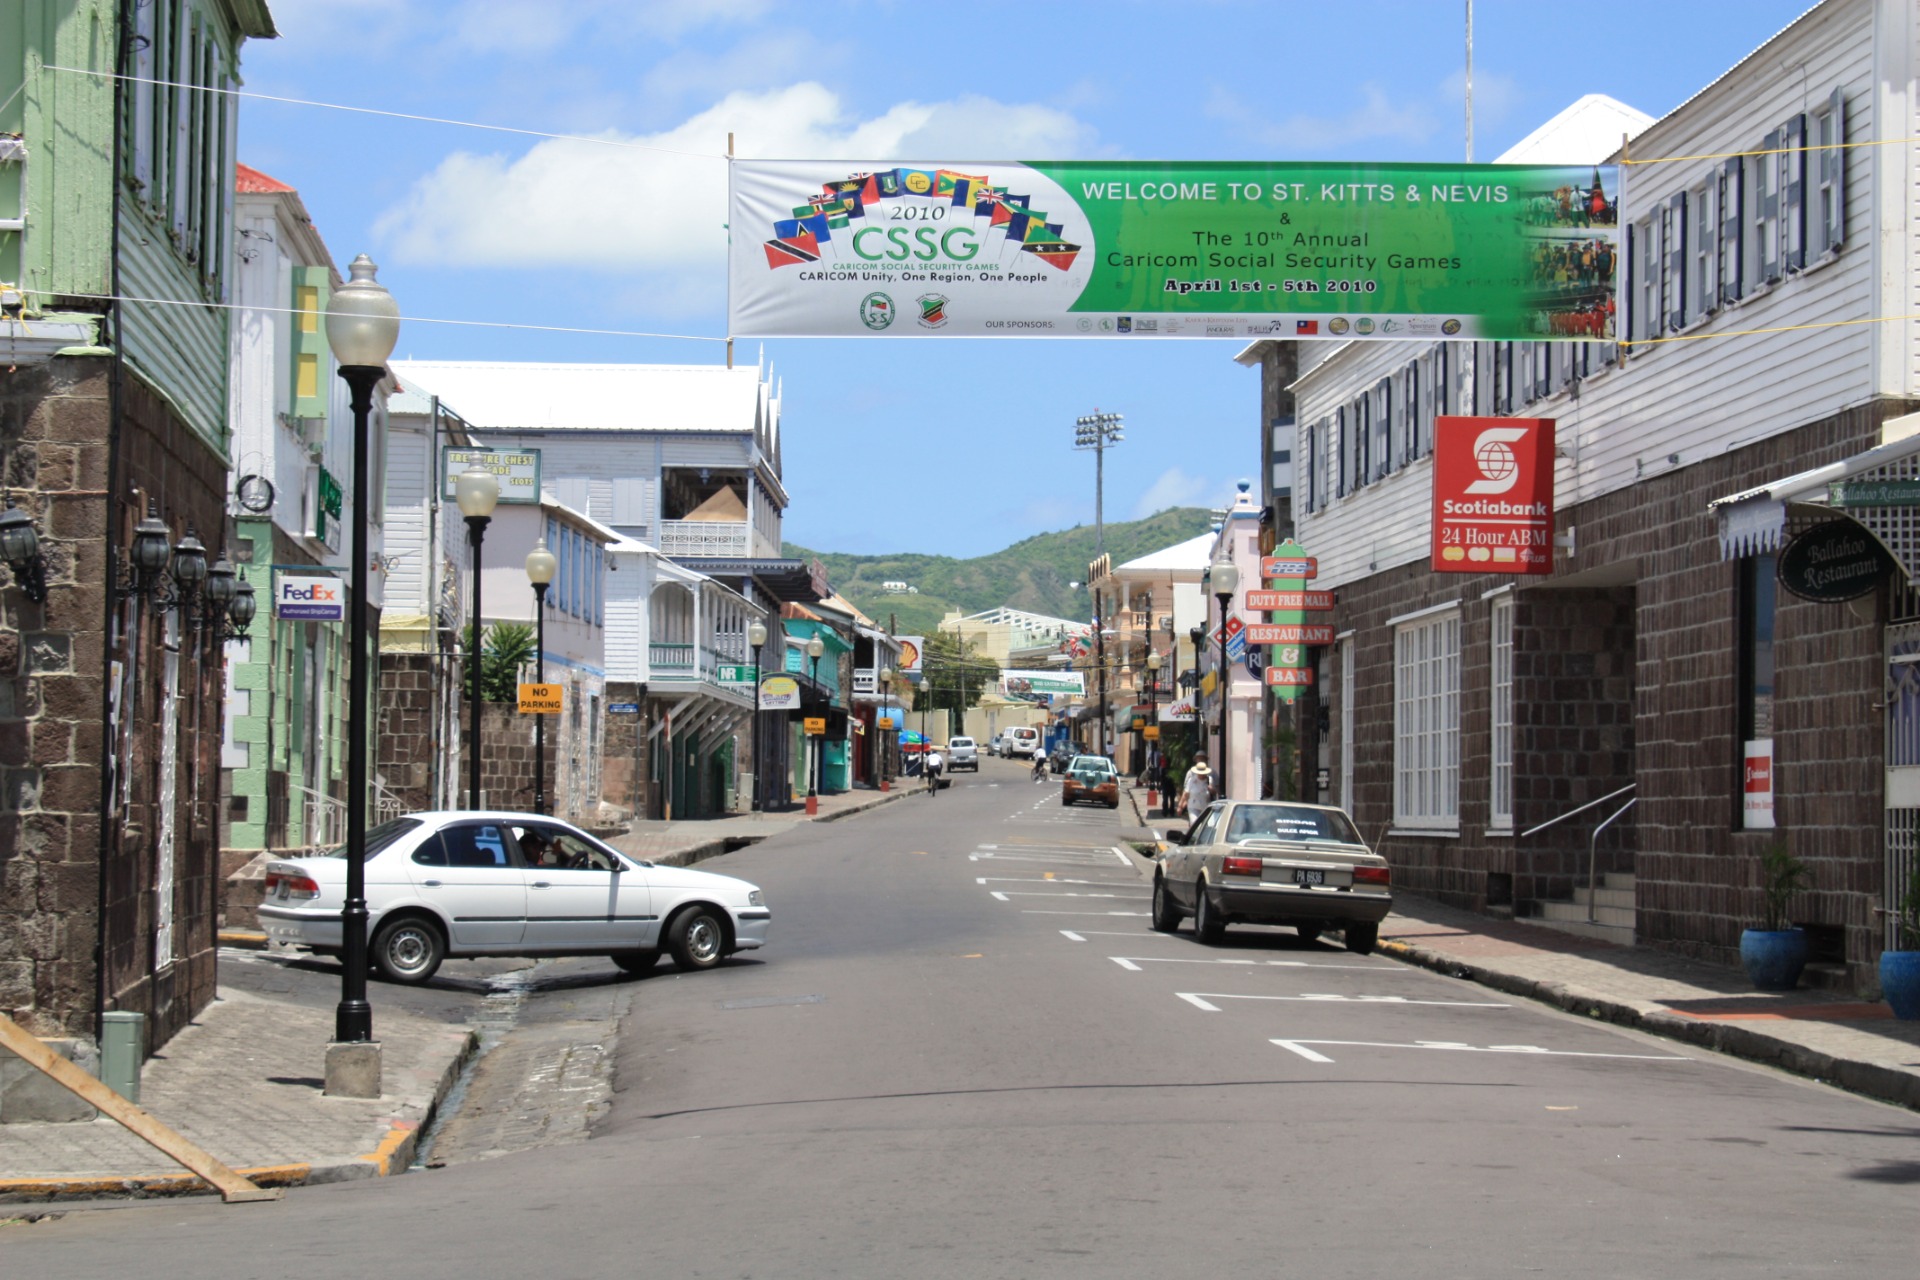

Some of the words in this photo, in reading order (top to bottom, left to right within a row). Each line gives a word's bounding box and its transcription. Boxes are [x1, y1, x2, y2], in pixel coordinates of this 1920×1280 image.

[1082, 182, 1217, 201] WELCOME
[1227, 183, 1262, 201] TO
[1272, 183, 1310, 202] ST.
[1321, 184, 1395, 202] KITTS
[1405, 184, 1421, 202] &
[1432, 185, 1509, 203] NEVIS
[890, 206, 945, 221] 2010
[1279, 212, 1291, 225] &
[852, 226, 979, 262] CSSG
[1192, 231, 1232, 246] The
[1244, 231, 1284, 247] 10th
[1293, 232, 1368, 247] Annual
[832, 263, 878, 271] CARICOM
[881, 263, 915, 271] SOCIAL
[918, 263, 962, 271] SECURITY
[1107, 251, 1198, 267] Caricom
[1209, 252, 1274, 268] Social
[1285, 252, 1376, 272] Security
[1387, 254, 1461, 269] Games
[799, 272, 858, 281] CARICOM
[862, 272, 897, 283] Unity,
[901, 272, 926, 281] One
[930, 273, 975, 283] Region,
[979, 273, 1004, 282] One
[1008, 273, 1048, 283] People
[1164, 279, 1222, 294] April
[1228, 279, 1262, 292] 1st
[1283, 280, 1319, 293] 5th
[1325, 281, 1377, 293] 2010
[450, 453, 499, 464] TRERE
[504, 455, 534, 465] CHEST
[509, 478, 533, 486] SLOTS
[1443, 499, 1547, 515] Scotiabank
[1442, 527, 1460, 544] 24
[1465, 527, 1505, 545] Hour
[1508, 529, 1547, 546] ABM
[1808, 536, 1865, 564] Ballahoo
[1803, 557, 1877, 589] Restaurant
[283, 583, 336, 600] FedEx
[1249, 594, 1276, 607] DUTY
[1278, 594, 1303, 607] FREE
[1304, 594, 1330, 607] MALL
[1249, 627, 1331, 641] RESTAURANT
[1281, 648, 1300, 664] &
[720, 667, 736, 680] NR
[1272, 670, 1308, 683] BAR
[532, 687, 548, 697] NO
[520, 700, 561, 709] PARKING
[1296, 870, 1305, 882] PA
